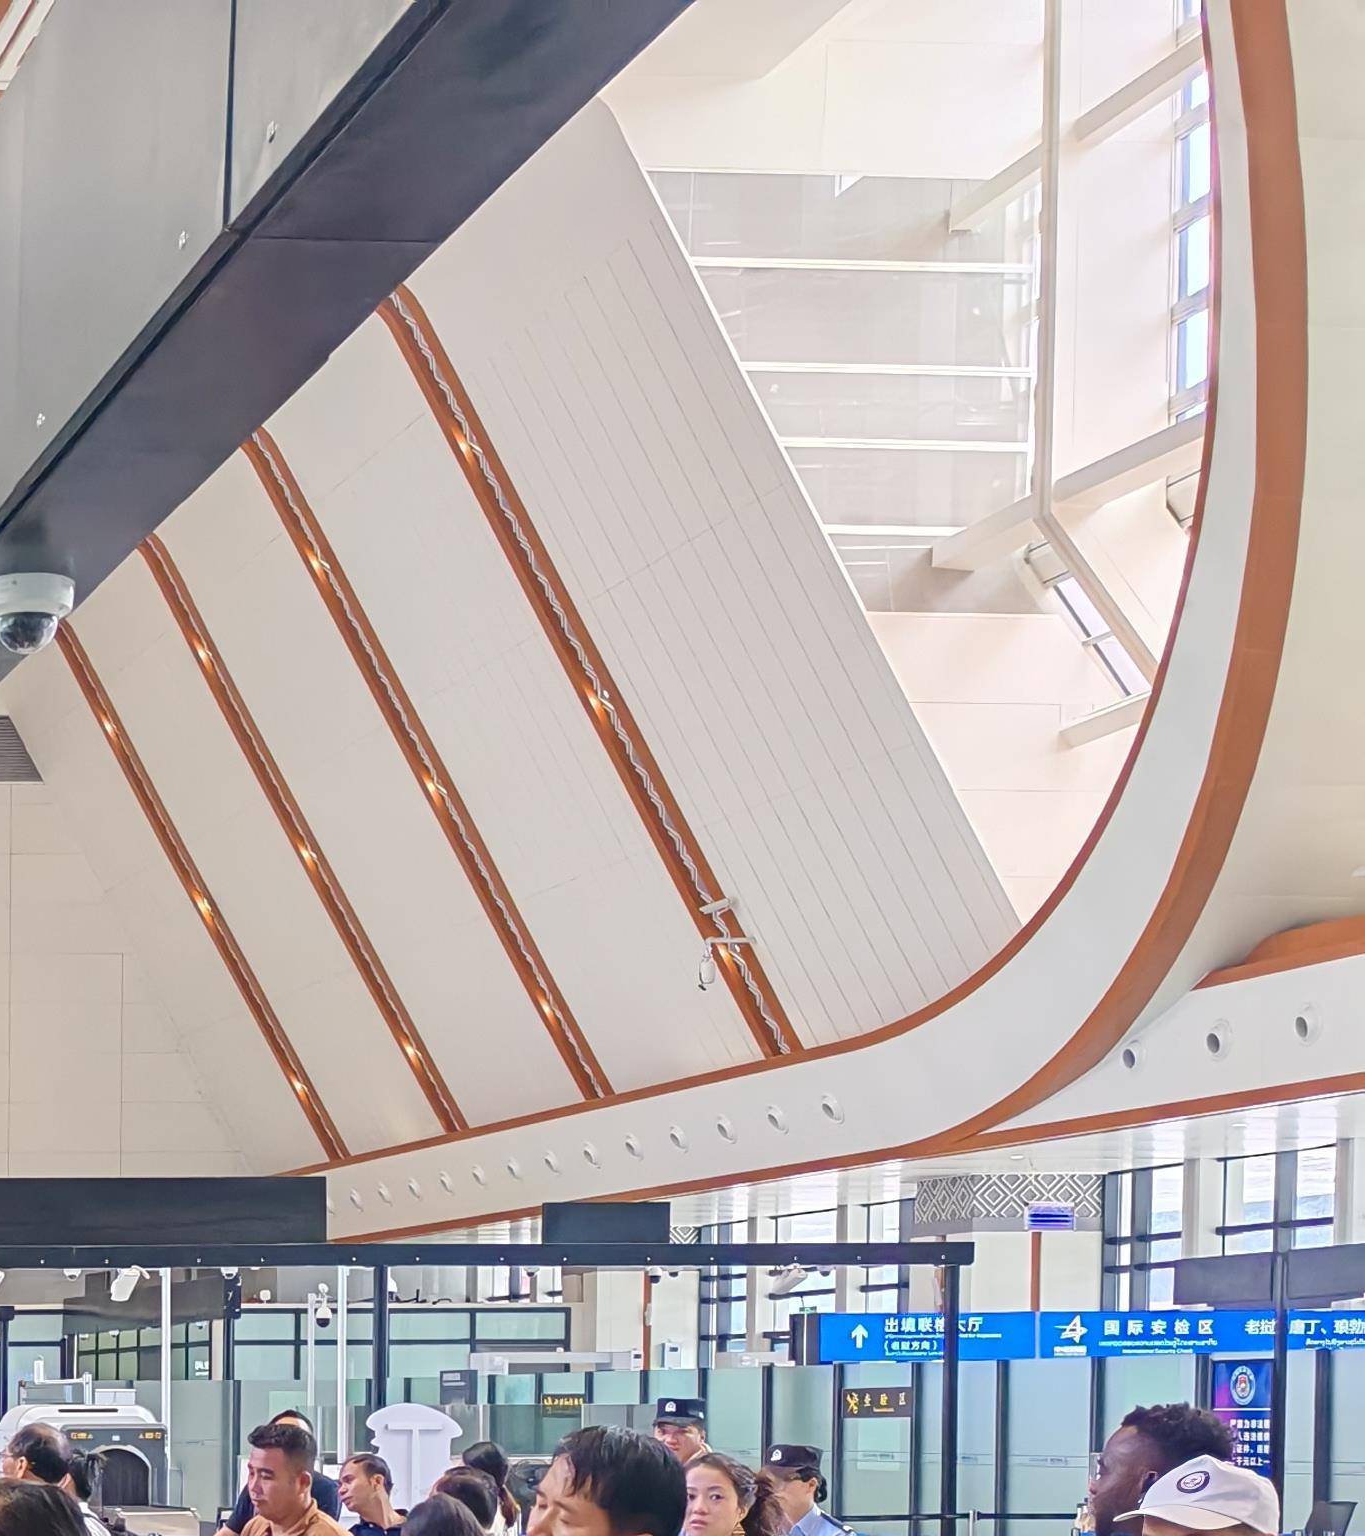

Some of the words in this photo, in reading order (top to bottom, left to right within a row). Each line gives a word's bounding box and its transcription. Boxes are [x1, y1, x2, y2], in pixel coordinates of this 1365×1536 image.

[1104, 1319, 1213, 1336] 国际安检区
